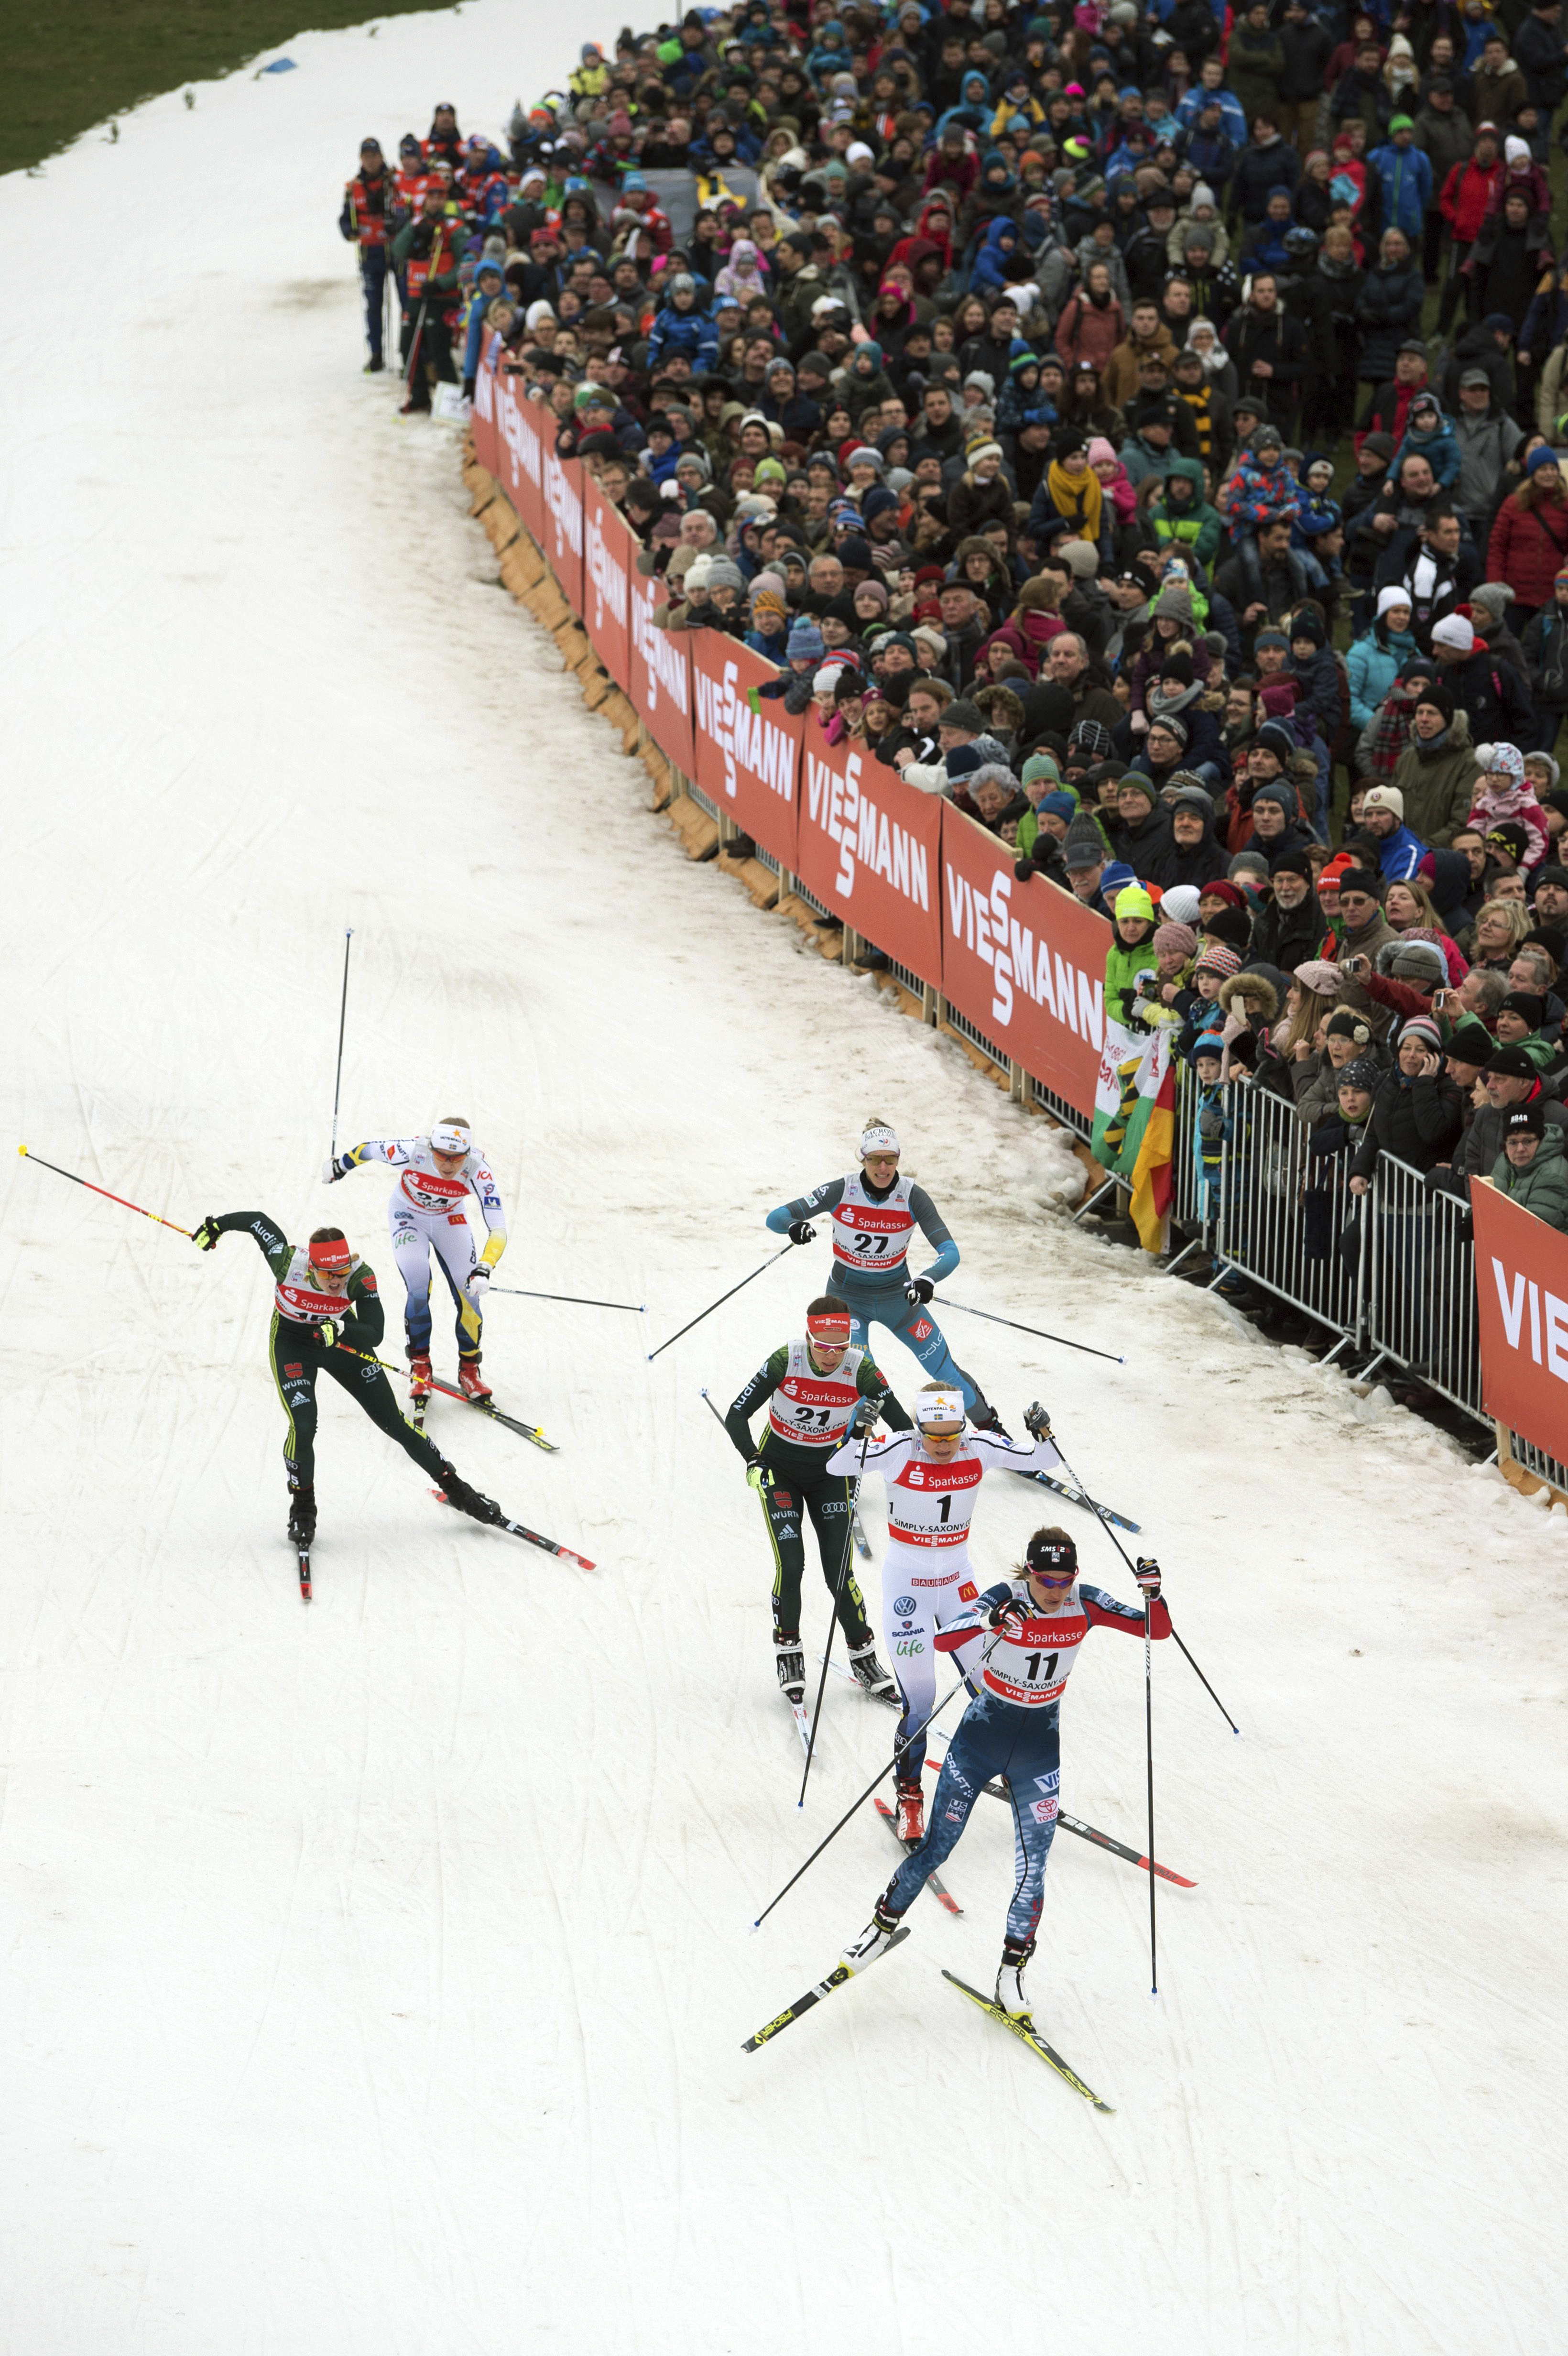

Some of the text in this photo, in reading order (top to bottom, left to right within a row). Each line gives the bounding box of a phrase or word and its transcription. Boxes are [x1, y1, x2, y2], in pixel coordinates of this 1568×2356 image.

[694, 660, 794, 802] VIESSMANN
[807, 751, 929, 912] VIESSMANN
[947, 862, 1102, 1053] VIESSMANN
[858, 1218, 907, 1230] Sparkasse
[250, 1220, 277, 1246] Audi
[854, 1233, 889, 1254] 27
[282, 1379, 311, 1391] WÜRTH
[290, 1397, 311, 1408] adidas
[732, 1382, 756, 1411] Audi
[800, 1390, 853, 1403] Sparkasse
[794, 1407, 831, 1427] 21
[928, 1473, 979, 1489] Sparkasse
[771, 1510, 799, 1520] WÜRTH
[936, 1494, 952, 1523] 1
[778, 1532, 798, 1541] adidas
[913, 1534, 965, 1547] VIESSMANN
[911, 1571, 960, 1587] BAUHAUS
[892, 1627, 925, 1637] SCANIA
[1027, 1631, 1082, 1645] Sparkasse
[896, 1639, 925, 1658] life
[1024, 1652, 1059, 1681] 11
[1005, 1686, 1057, 1702] VIESSMANN
[947, 1752, 971, 1789] CRAFT
[950, 1800, 967, 1810] US
[760, 2010, 793, 2037] FISCHER
[989, 2007, 1026, 2039] FISCHER
